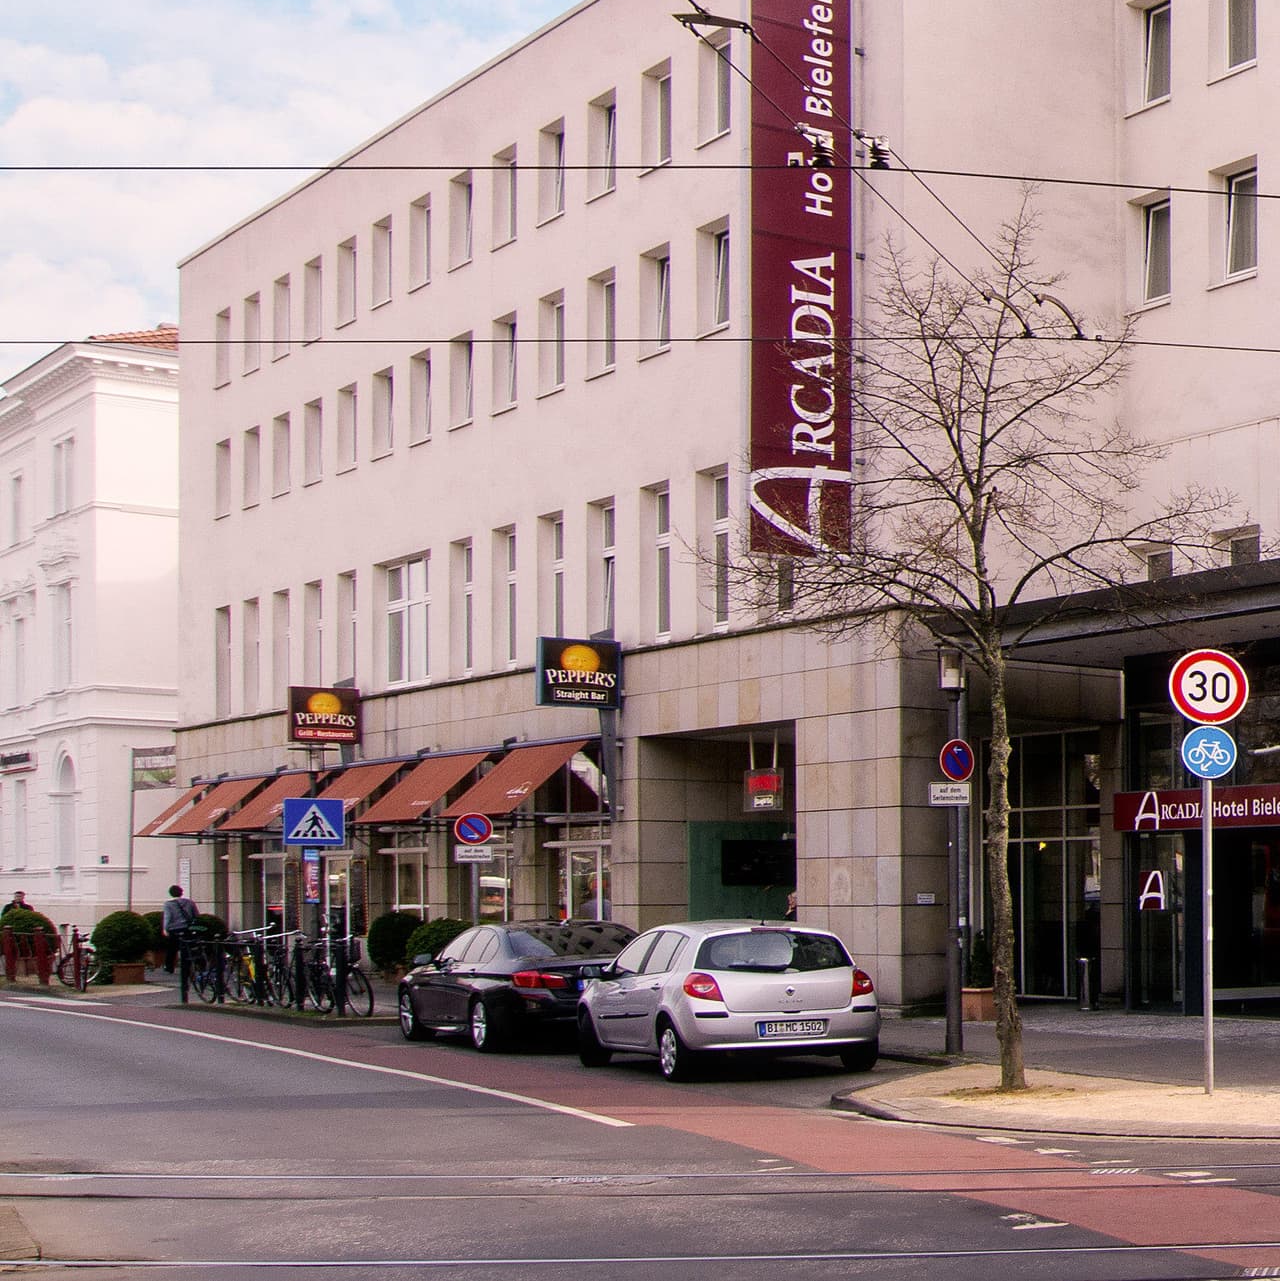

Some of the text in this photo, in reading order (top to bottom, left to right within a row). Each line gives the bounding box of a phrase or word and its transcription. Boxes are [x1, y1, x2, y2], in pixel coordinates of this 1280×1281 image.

[545, 669, 616, 688] PEPPER'S
[1188, 670, 1230, 703] 30
[556, 689, 605, 701] Straight Bar
[296, 712, 356, 727] PEPPER'S
[1213, 799, 1248, 818] Hotel
[1139, 870, 1165, 910] A
[767, 1021, 822, 1033] BI MC 1502
